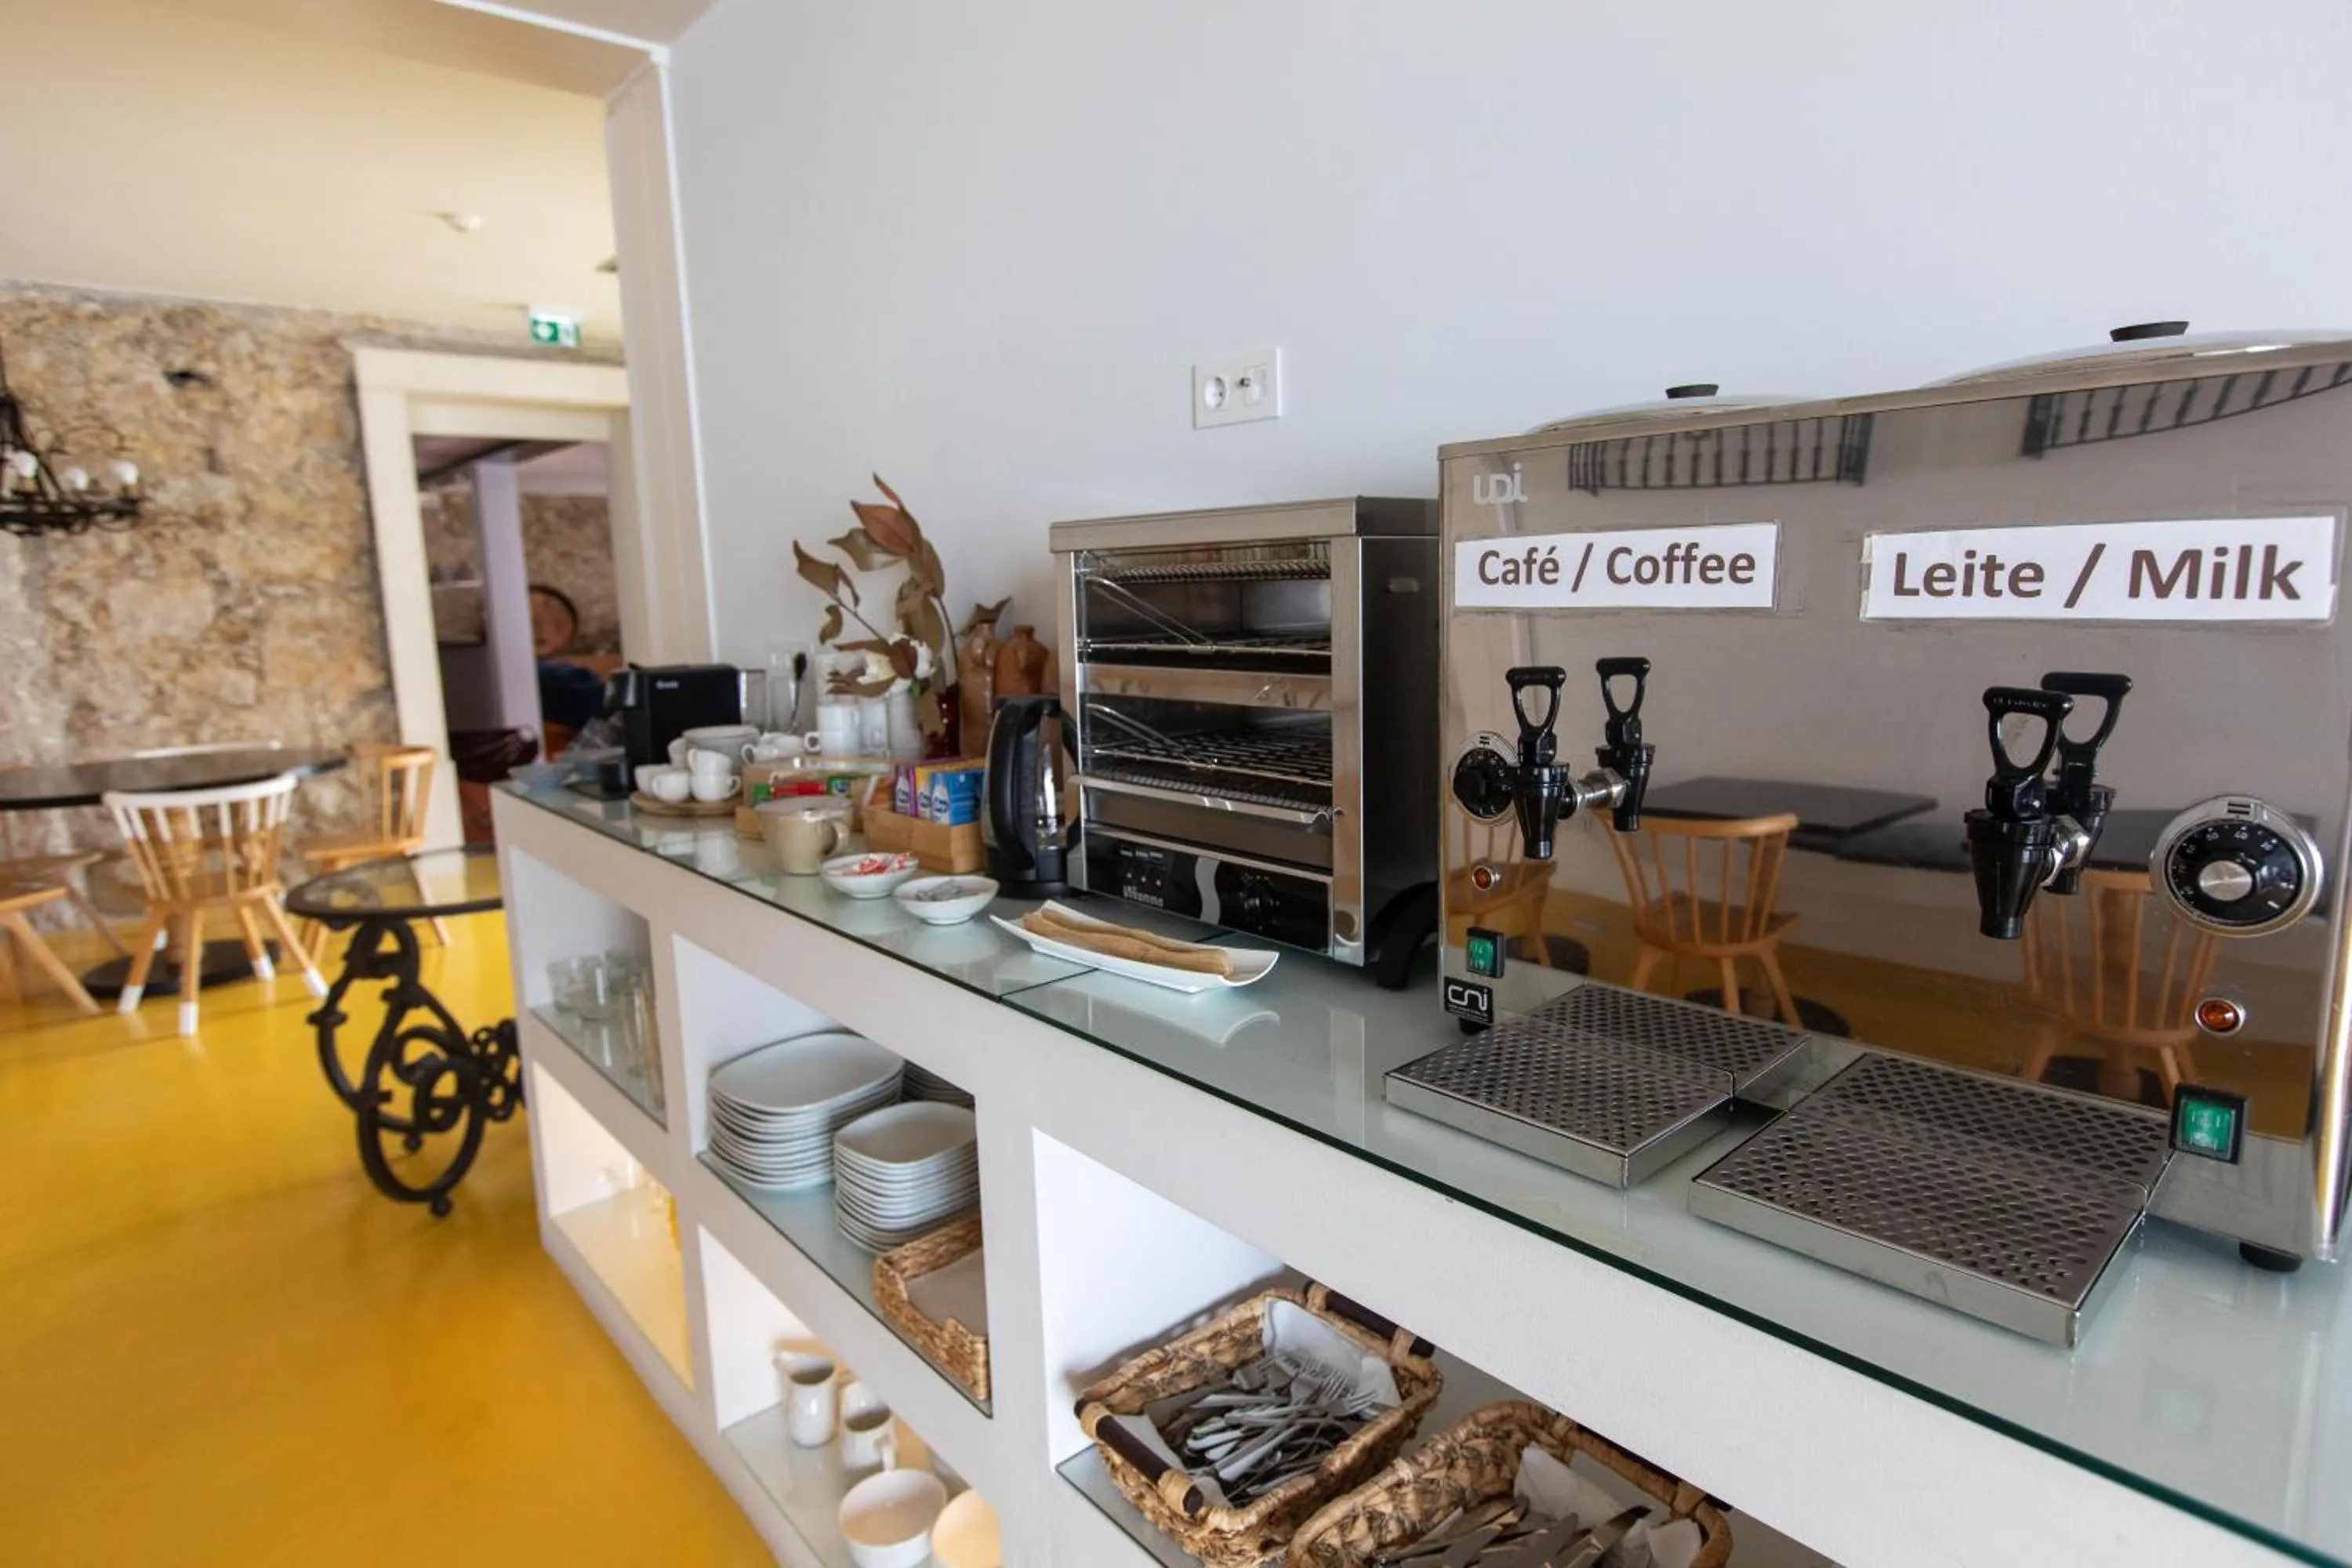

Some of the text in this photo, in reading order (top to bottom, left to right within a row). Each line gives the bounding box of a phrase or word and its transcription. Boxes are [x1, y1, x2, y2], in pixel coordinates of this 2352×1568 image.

[1479, 543, 1755, 593] Café / Coffee
[1894, 543, 2303, 608] Leite / Milk
